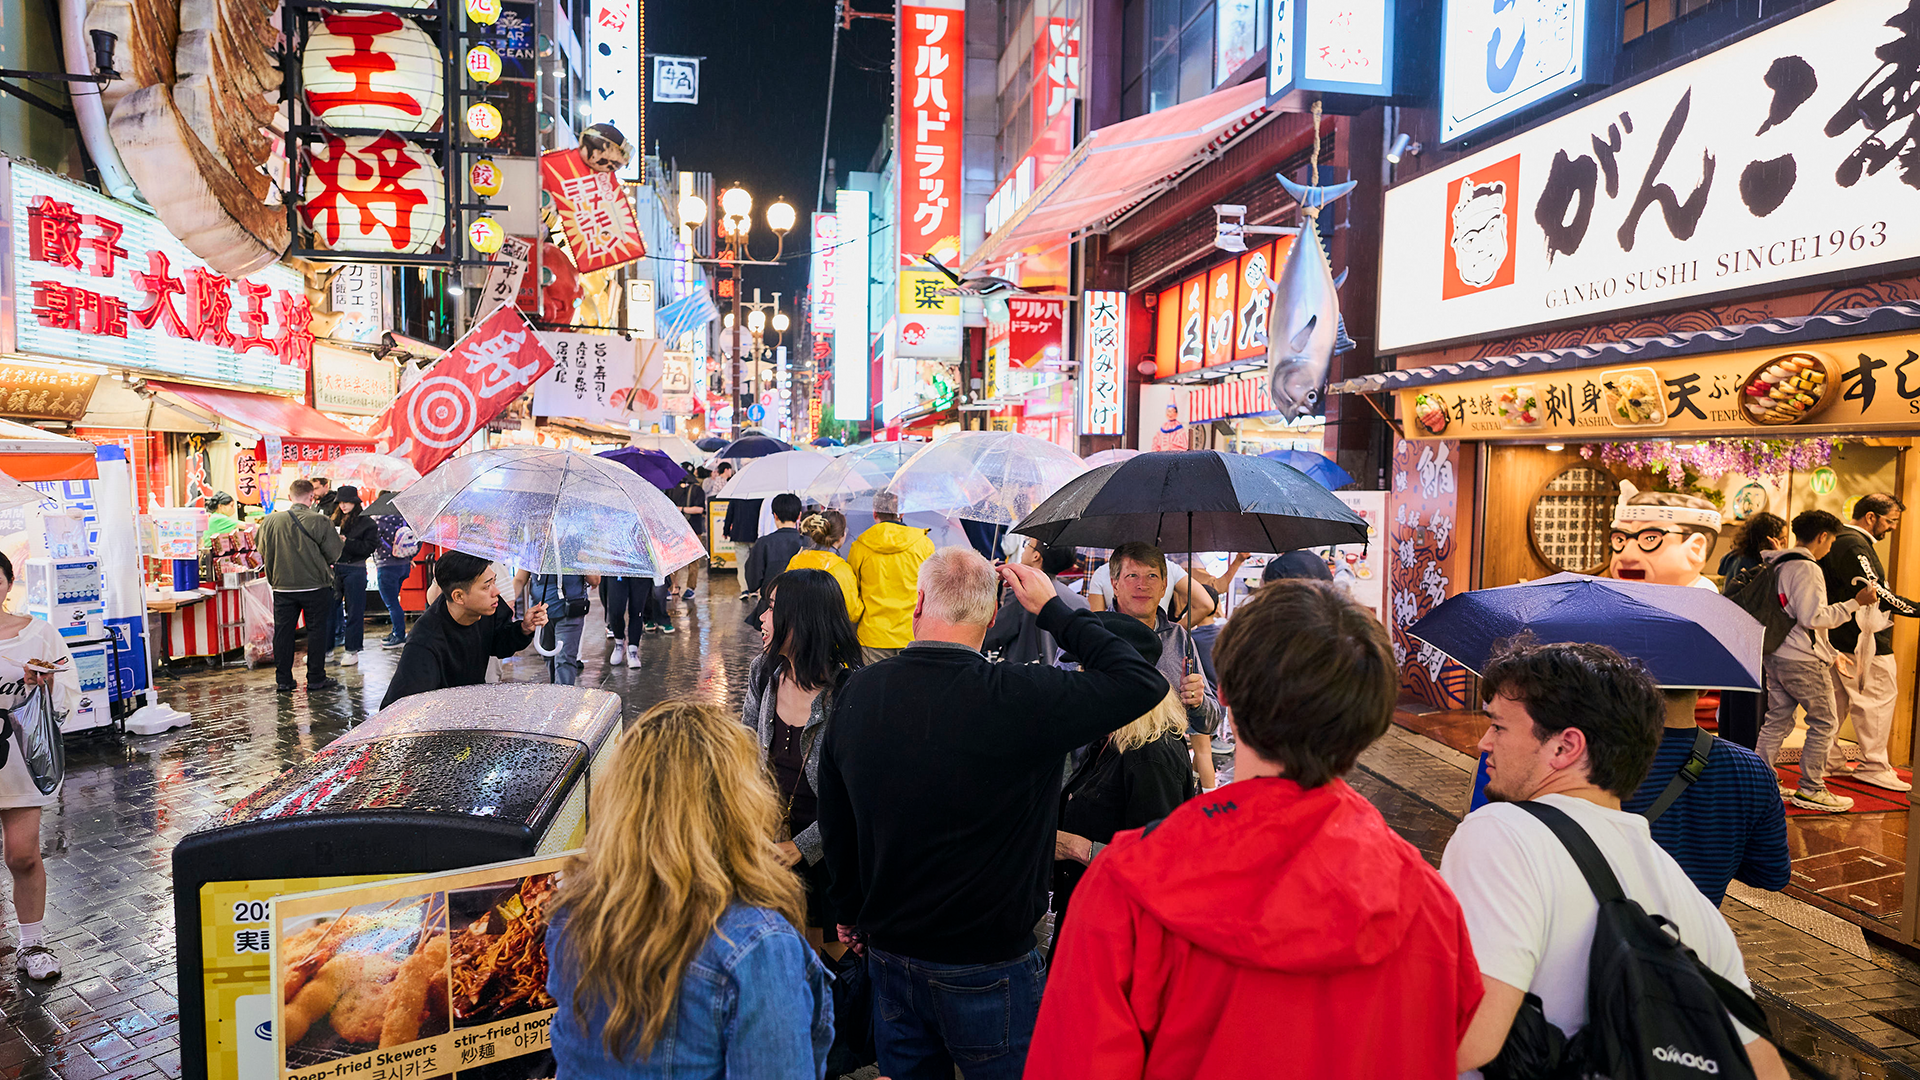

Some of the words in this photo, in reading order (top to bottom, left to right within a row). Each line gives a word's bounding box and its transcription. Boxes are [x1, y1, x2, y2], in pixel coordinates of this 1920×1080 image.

[494, 48, 534, 59] CEAN
[662, 67, 692, 90] 牛角
[297, 10, 430, 252] 王将
[913, 13, 950, 236] ツルハドラッグ
[28, 194, 128, 278] 餃子
[349, 265, 365, 305] カフェ
[915, 279, 945, 309] 薬
[1545, 277, 1617, 310] GANKO
[1624, 258, 1700, 295] SUSHI
[129, 250, 316, 370] 大阪王将
[370, 291, 379, 322] CAFE
[1011, 301, 1061, 319] ツルハ
[1011, 321, 1052, 334] ドラッグ
[1093, 300, 1118, 425] 大阪みやげ
[1546, 380, 1601, 428] 刺身
[238, 455, 257, 496] 餃子
[376, 1043, 437, 1066] Skewers
[454, 1022, 520, 1048] stir-fried
